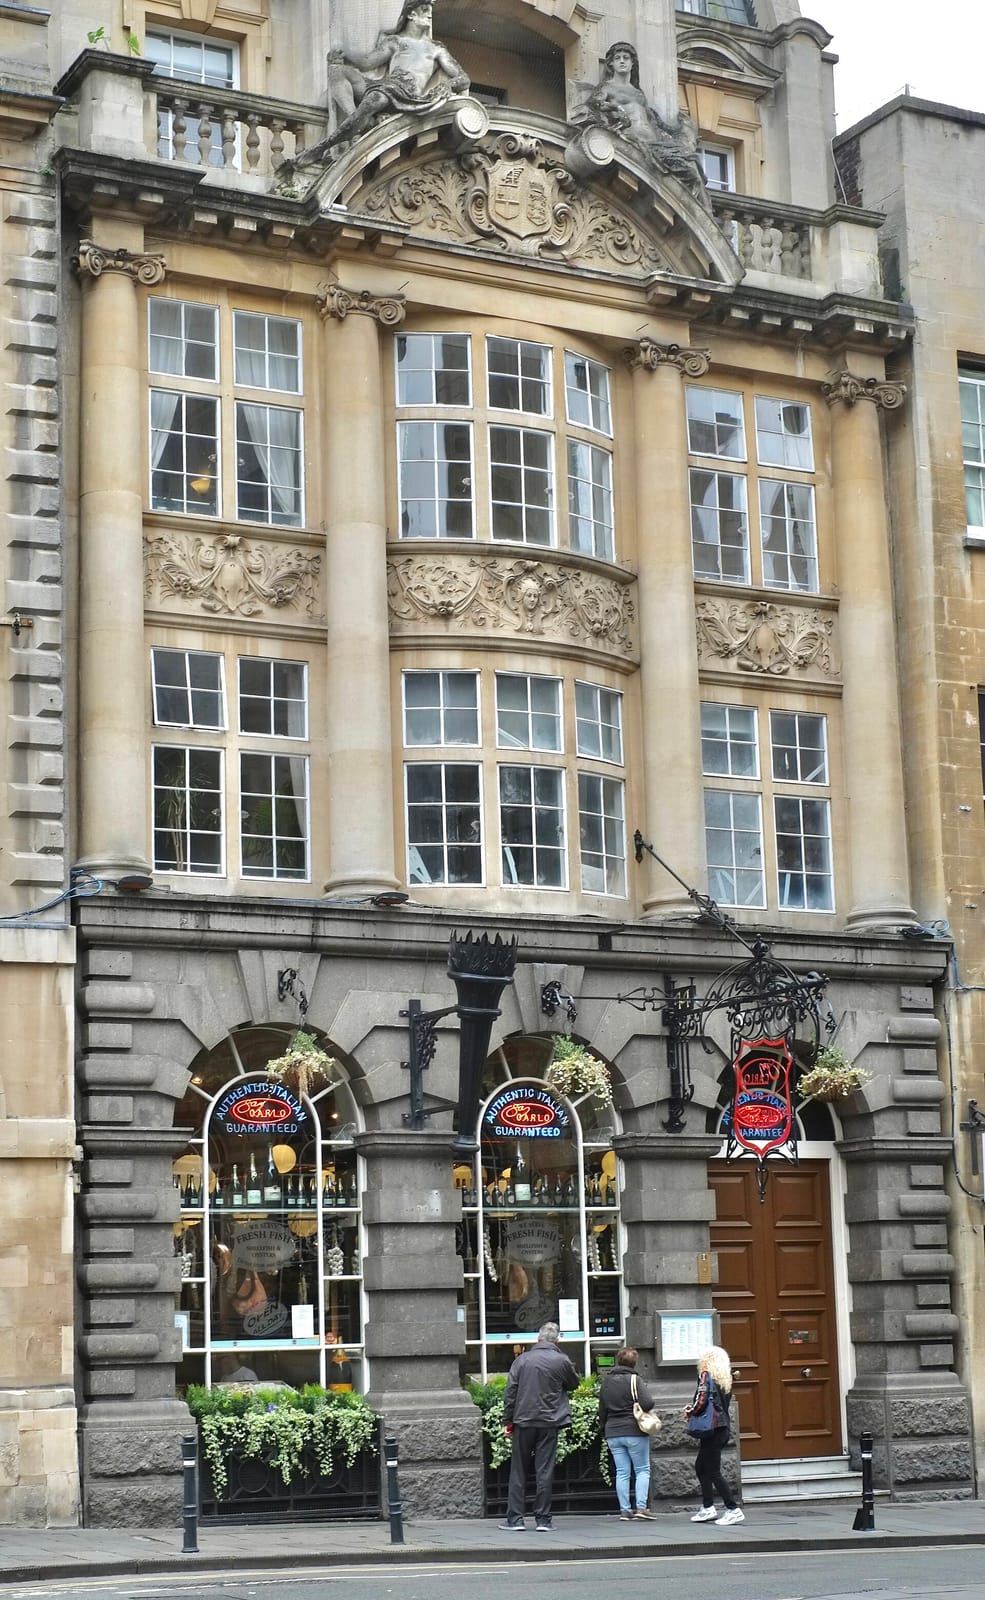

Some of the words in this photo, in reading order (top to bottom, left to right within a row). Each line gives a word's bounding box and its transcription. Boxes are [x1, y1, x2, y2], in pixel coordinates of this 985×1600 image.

[272, 1084, 308, 1122] ITALIAN
[486, 1088, 535, 1125] AUTHENTIC
[537, 1090, 569, 1127] ITALIAN
[249, 1109, 286, 1118] CARLO
[516, 1113, 550, 1122] CARLO
[226, 1123, 298, 1133] GUARANTEED
[495, 1127, 561, 1137] GUARANTEED
[236, 1230, 266, 1245] FRESH
[269, 1230, 291, 1244] FISH
[507, 1229, 534, 1242] FRESH
[537, 1229, 557, 1242] FISH
